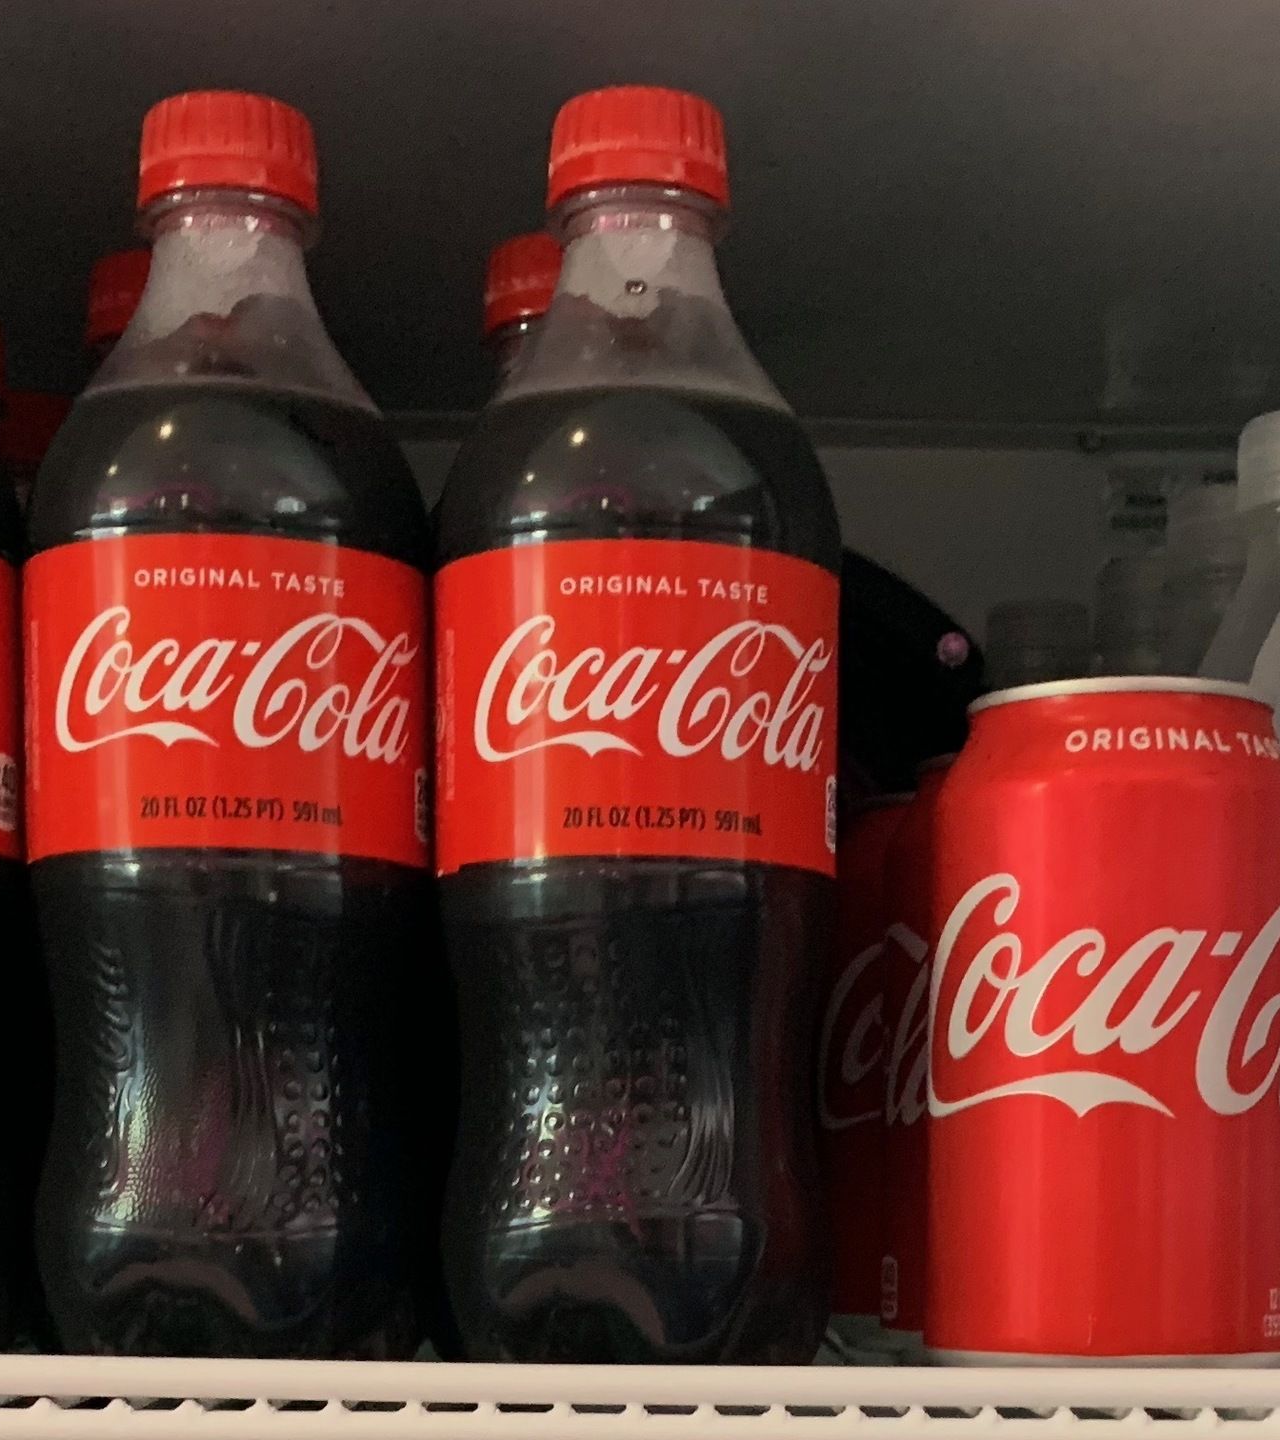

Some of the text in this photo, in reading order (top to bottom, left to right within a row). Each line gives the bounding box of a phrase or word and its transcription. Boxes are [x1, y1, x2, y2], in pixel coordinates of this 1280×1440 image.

[133, 567, 345, 598] ORIGINAL TASTE
[559, 575, 770, 605] ORIGINAL TASTE
[55, 605, 418, 765] Coca-Cola
[474, 614, 833, 772] Coca-Cola
[1065, 726, 1280, 760] ORIGINAL TAS
[140, 797, 160, 819] 20
[163, 798, 181, 818] FL
[185, 797, 207, 818] OZ
[211, 797, 252, 820] (1.25
[256, 798, 285, 822] PT)
[292, 800, 319, 823] 591
[562, 806, 583, 829] 20
[586, 807, 605, 828] FL
[609, 806, 630, 828] OZ
[634, 806, 676, 830] (1.25
[678, 807, 706, 831] PT)
[714, 809, 740, 833] 591
